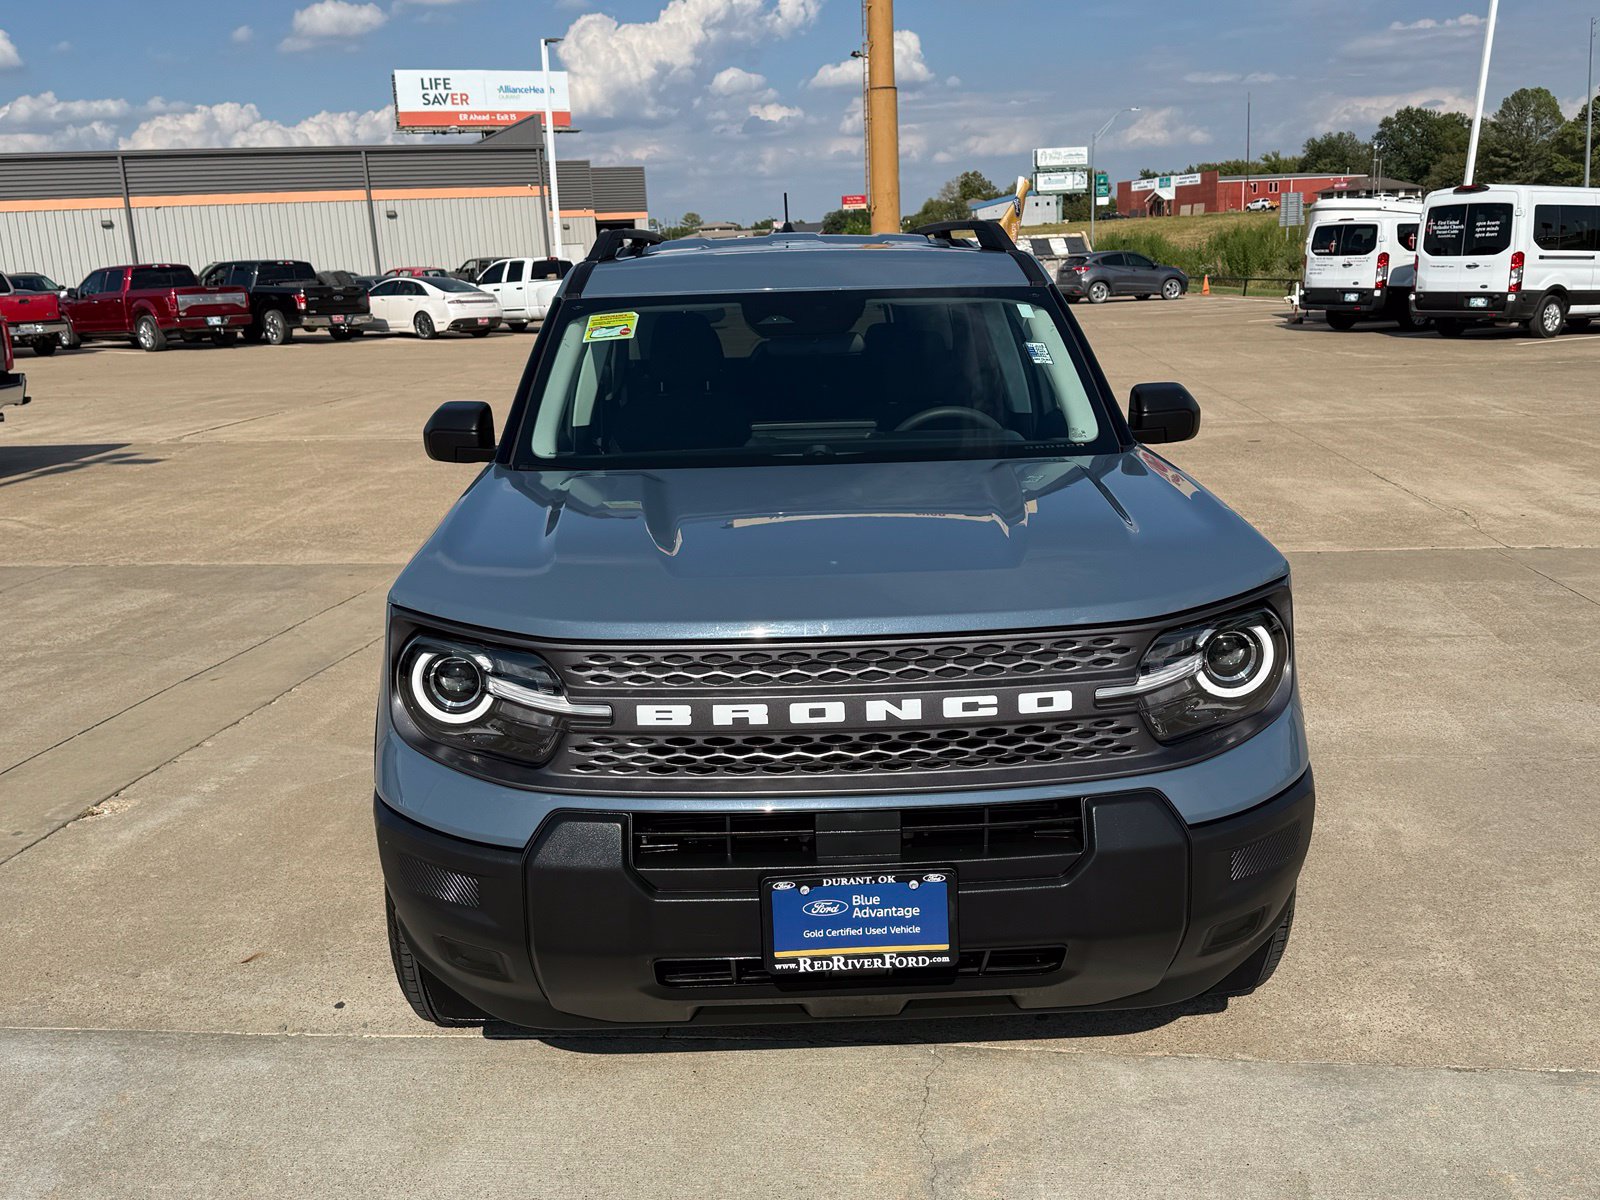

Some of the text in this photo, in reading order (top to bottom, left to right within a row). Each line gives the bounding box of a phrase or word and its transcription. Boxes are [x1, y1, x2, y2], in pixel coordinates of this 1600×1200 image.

[421, 77, 452, 90] LIFE
[498, 85, 555, 94] AllianceHeah
[422, 93, 469, 105] SAVER
[459, 113, 468, 121] ER
[469, 113, 490, 121] Ahead
[636, 690, 1073, 727] BRONCO
[822, 875, 896, 887] DURANT, OK
[852, 894, 881, 906] Blue
[811, 901, 840, 914] Ford
[852, 906, 920, 919] Advantage
[803, 924, 921, 938] Gold Certified Used Vehicle
